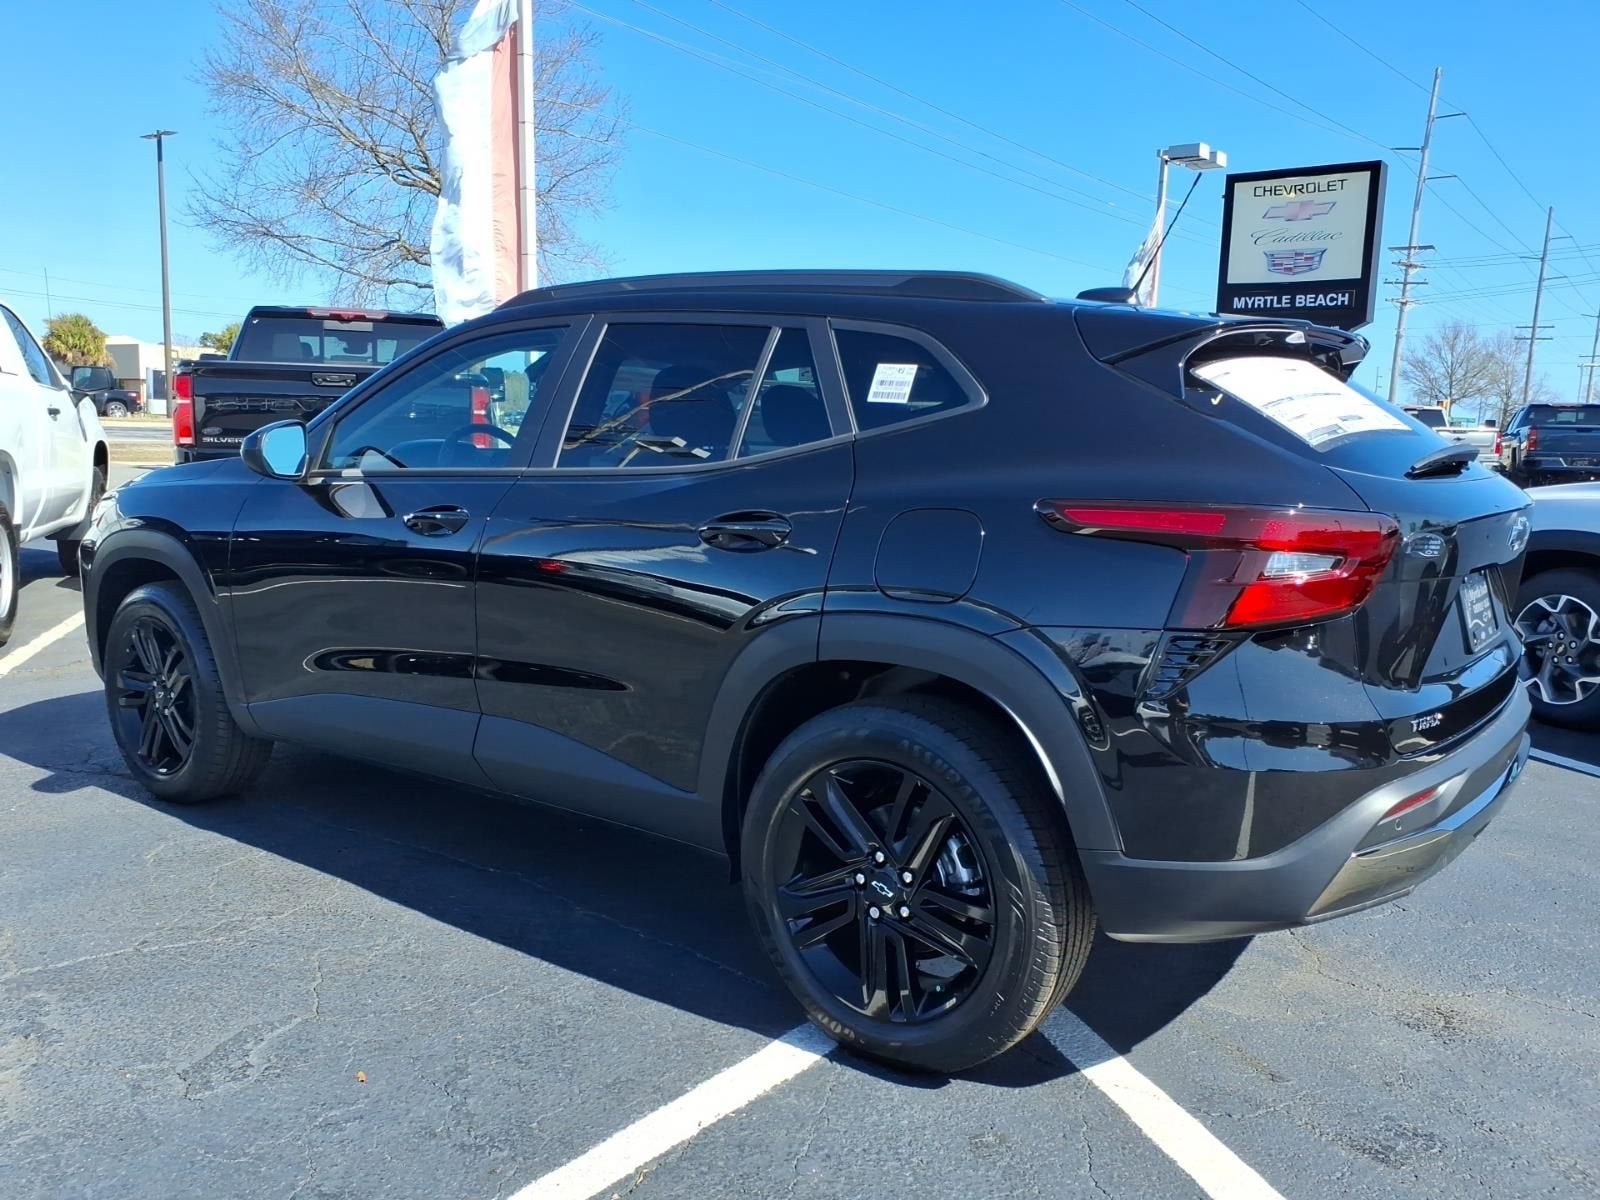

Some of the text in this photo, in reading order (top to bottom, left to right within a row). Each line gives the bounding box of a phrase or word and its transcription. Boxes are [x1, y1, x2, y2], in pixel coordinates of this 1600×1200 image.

[1253, 179, 1348, 198] CHEVROLET
[1250, 227, 1343, 246] Cadillac
[1233, 293, 1349, 309] MYRTLE BEACH
